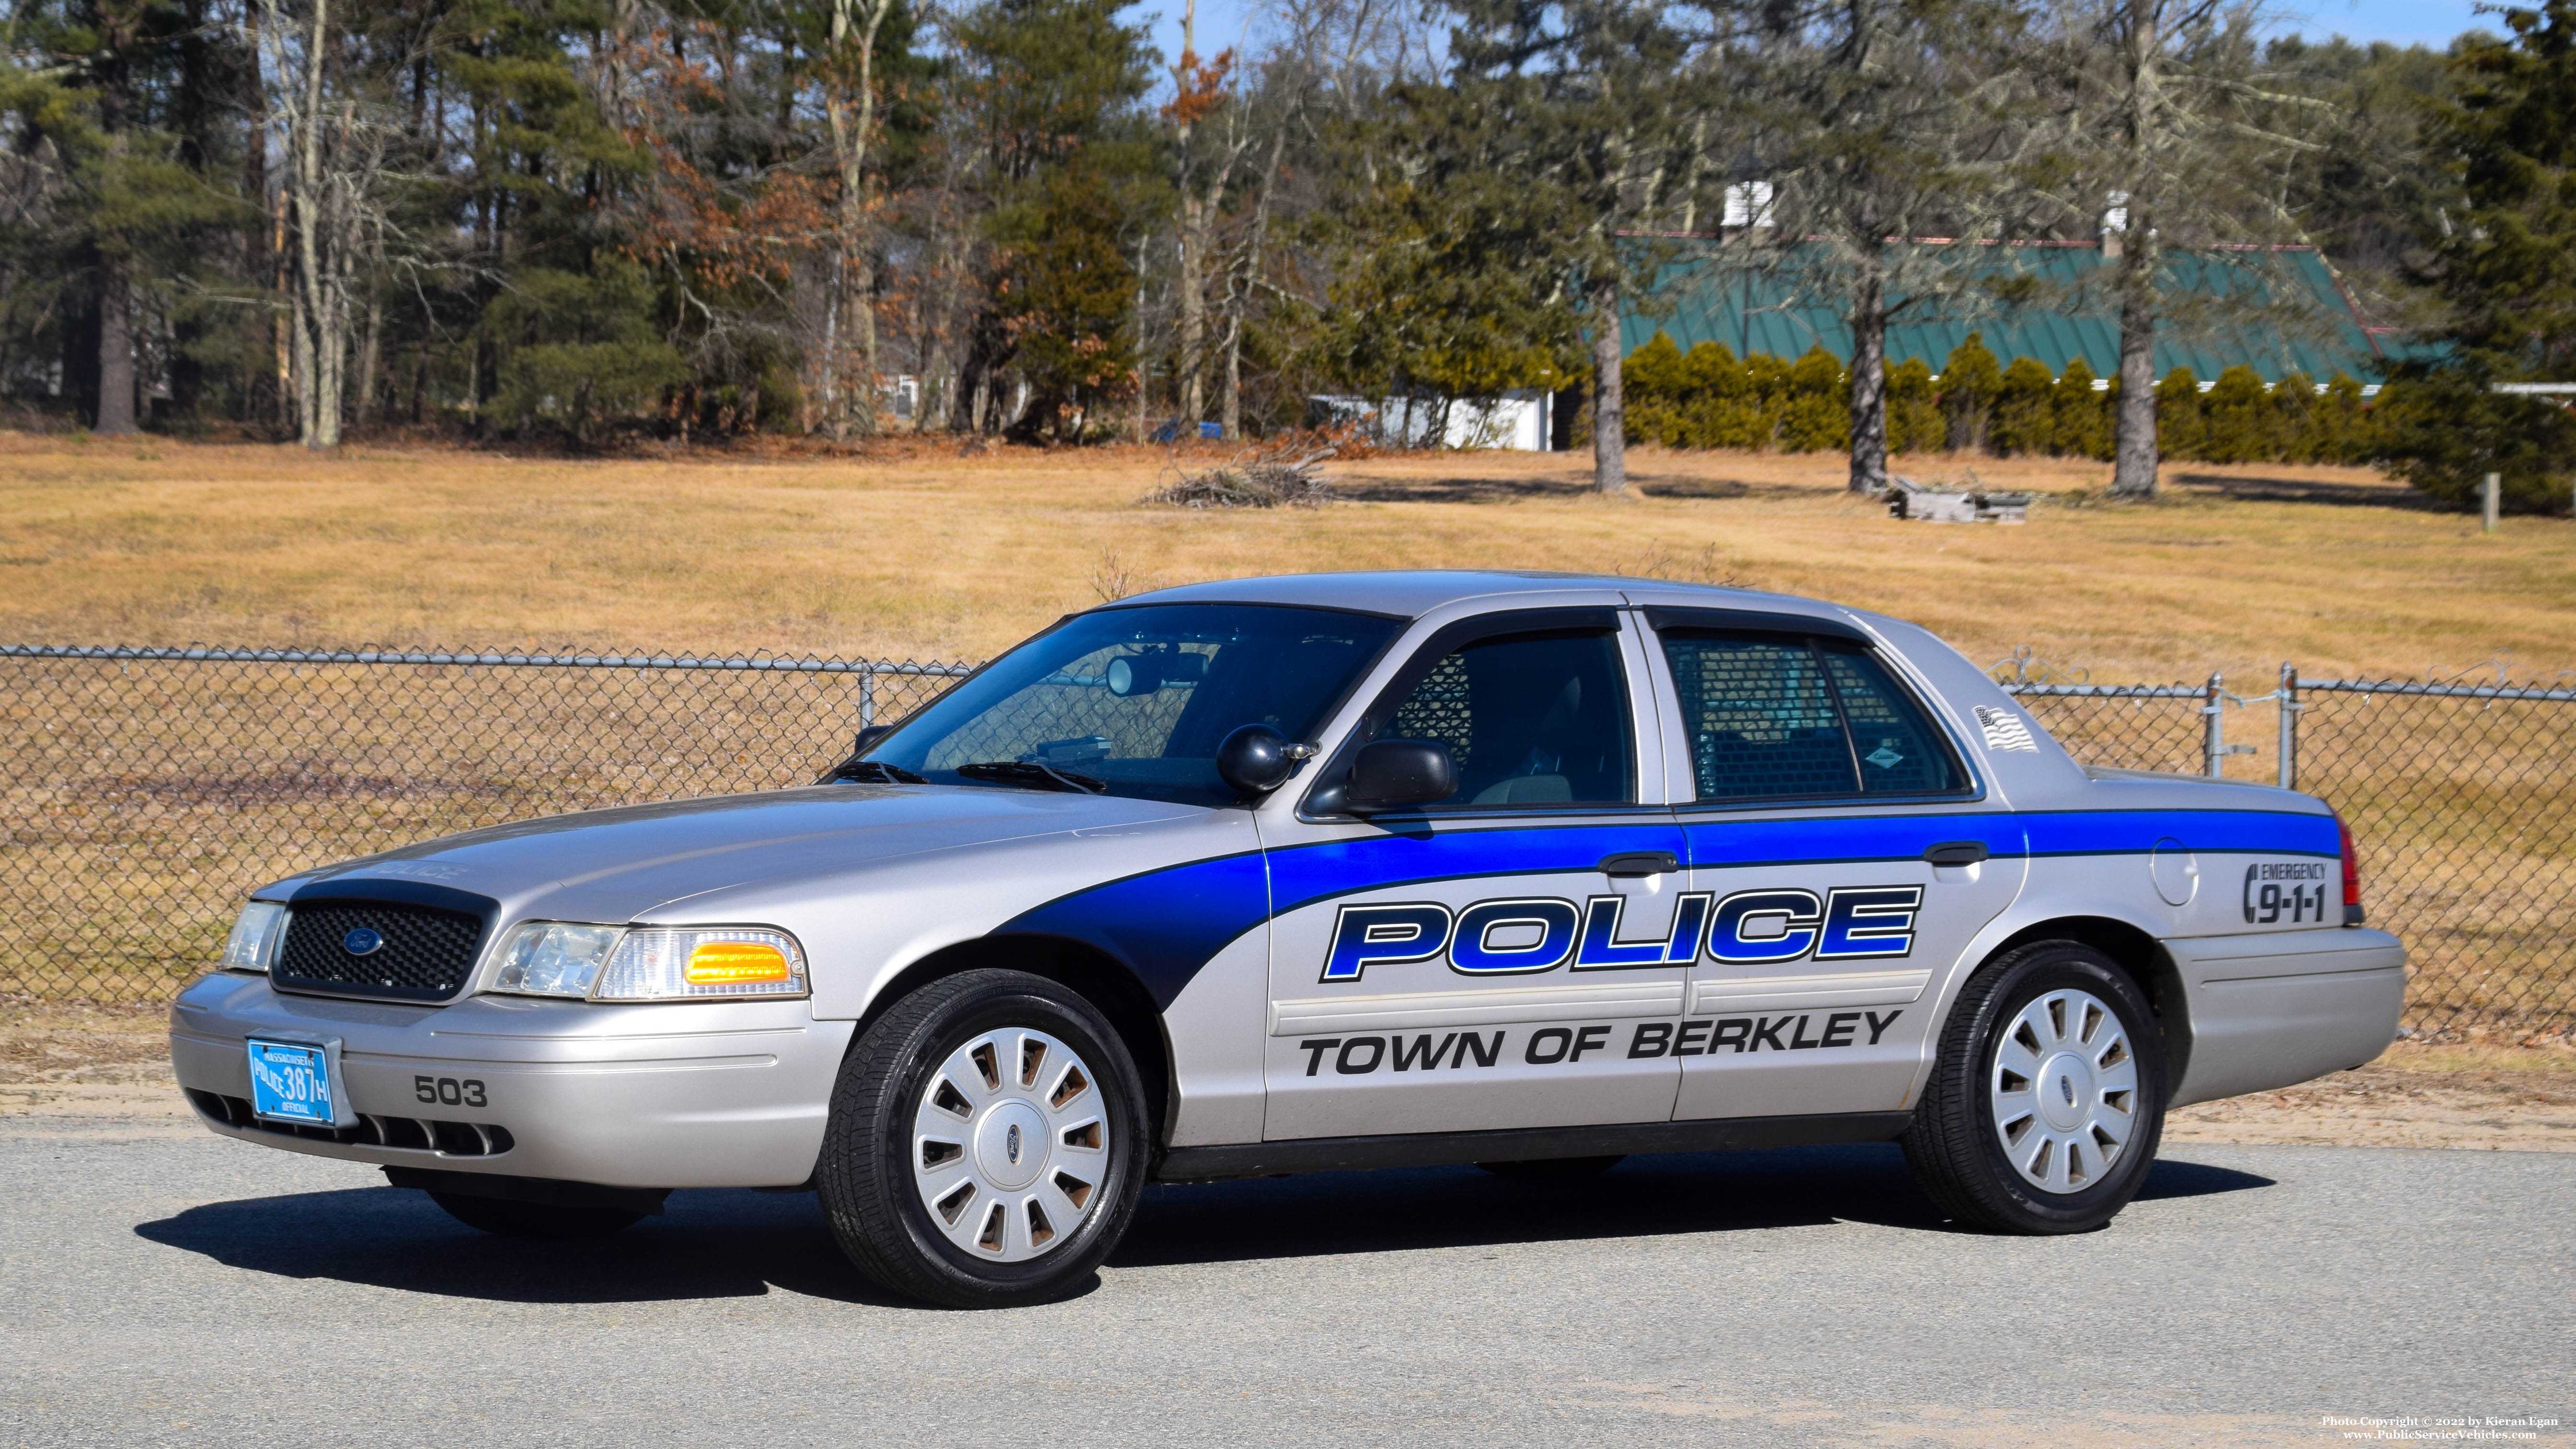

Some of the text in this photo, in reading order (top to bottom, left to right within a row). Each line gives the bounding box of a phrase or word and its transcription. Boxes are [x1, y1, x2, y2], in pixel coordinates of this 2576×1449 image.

[2262, 863, 2327, 879] EMERGENCY
[2259, 883, 2325, 923] 9-1-1
[1318, 884, 1925, 983] POLICE
[1299, 1010, 1905, 1076] TOWN OF BERKLEY
[254, 1056, 284, 1098] POLICE
[414, 1075, 488, 1108] 503
[282, 1101, 310, 1115] OFFICIAL
[1010, 1133, 1019, 1155] Ford
